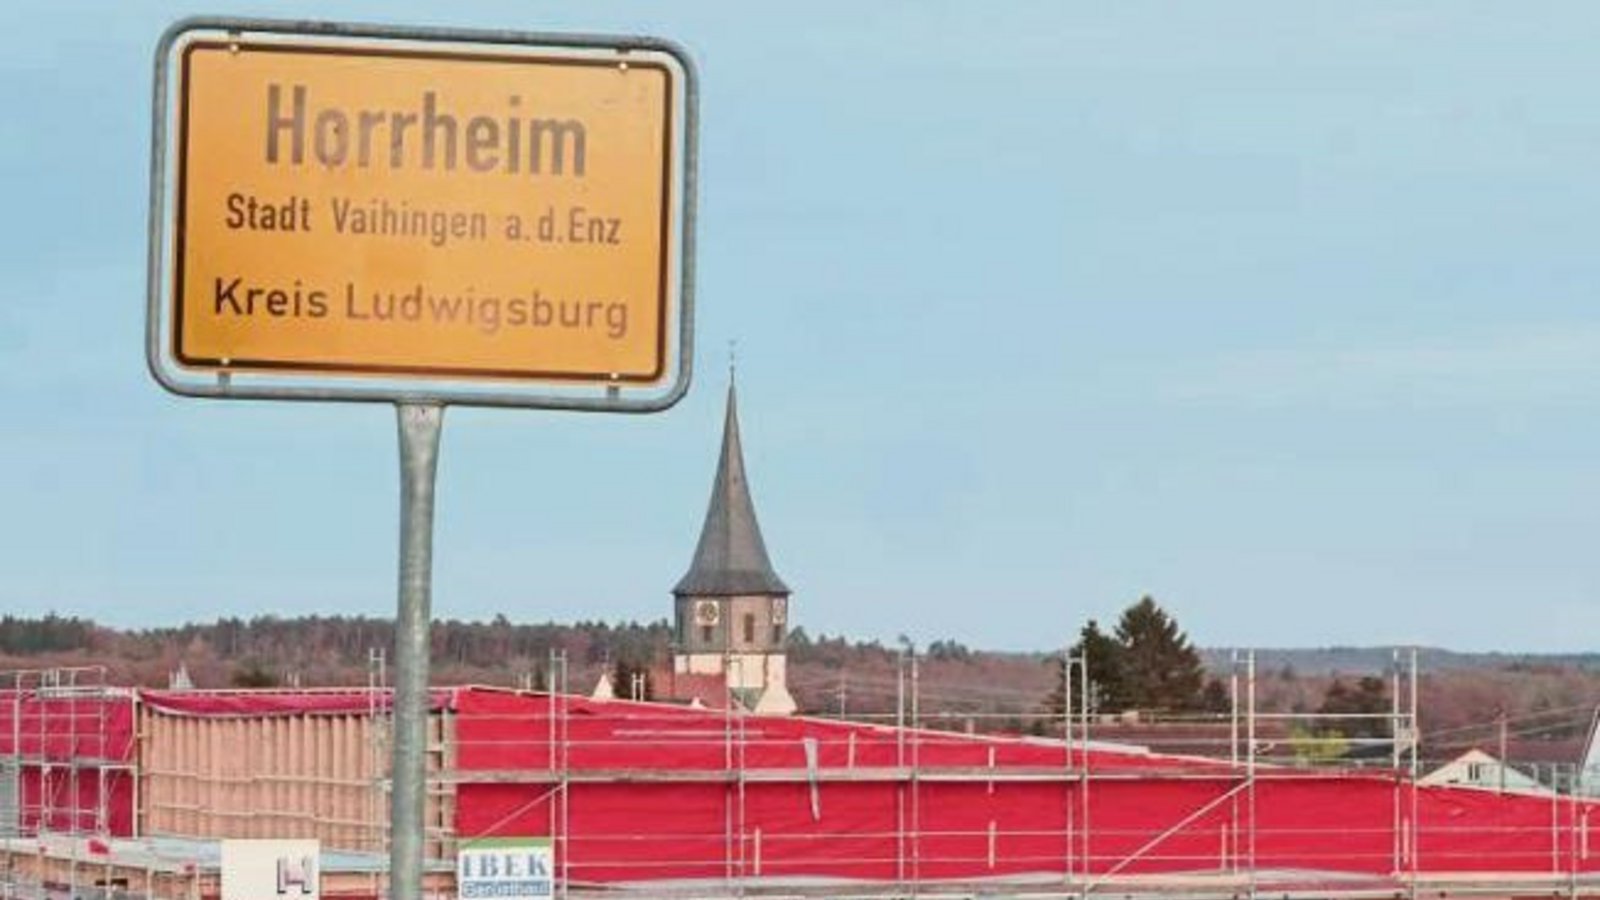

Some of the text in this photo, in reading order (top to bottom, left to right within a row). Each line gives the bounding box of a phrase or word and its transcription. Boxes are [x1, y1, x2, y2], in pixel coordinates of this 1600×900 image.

[265, 85, 588, 177] Horrheim
[225, 193, 311, 233] Stadt
[331, 197, 487, 246] Vaihingen
[213, 277, 630, 338] Kreis Ludwigsburg
[461, 853, 548, 879] IBEK
